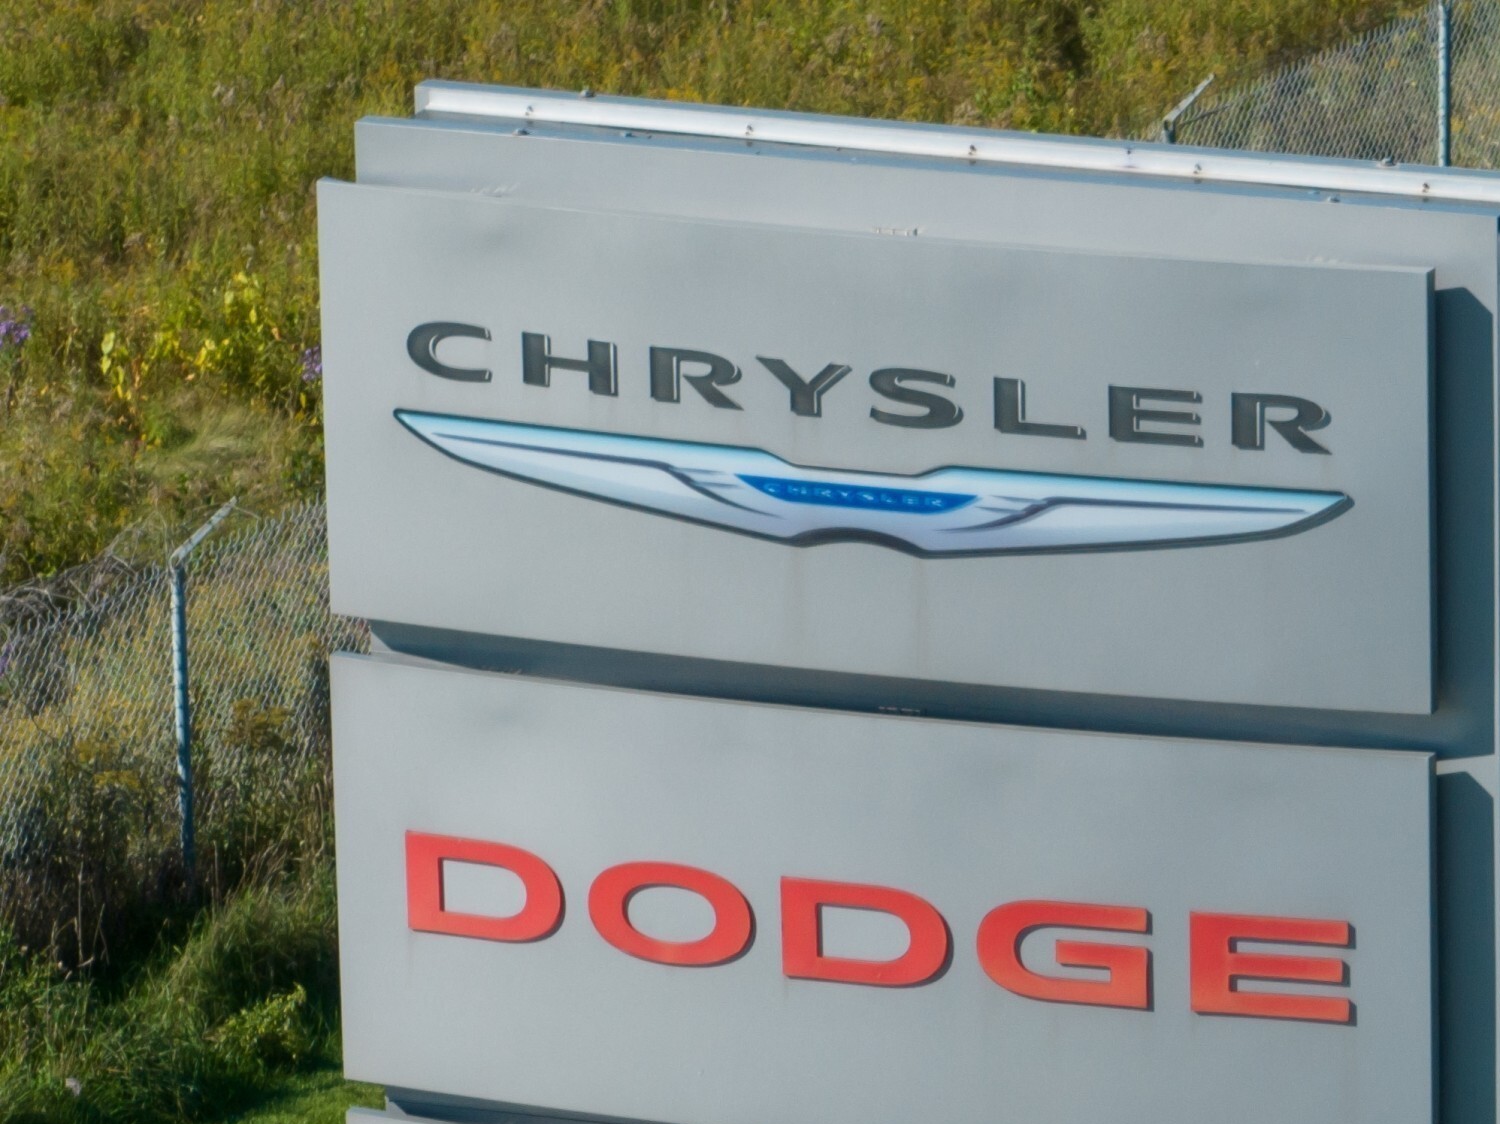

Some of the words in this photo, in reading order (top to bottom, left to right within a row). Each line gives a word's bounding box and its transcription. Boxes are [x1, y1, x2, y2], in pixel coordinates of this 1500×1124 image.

[405, 321, 1333, 456] CHRYSLER
[763, 482, 944, 508] CHRYSLER
[404, 830, 1358, 1027] DODGE
